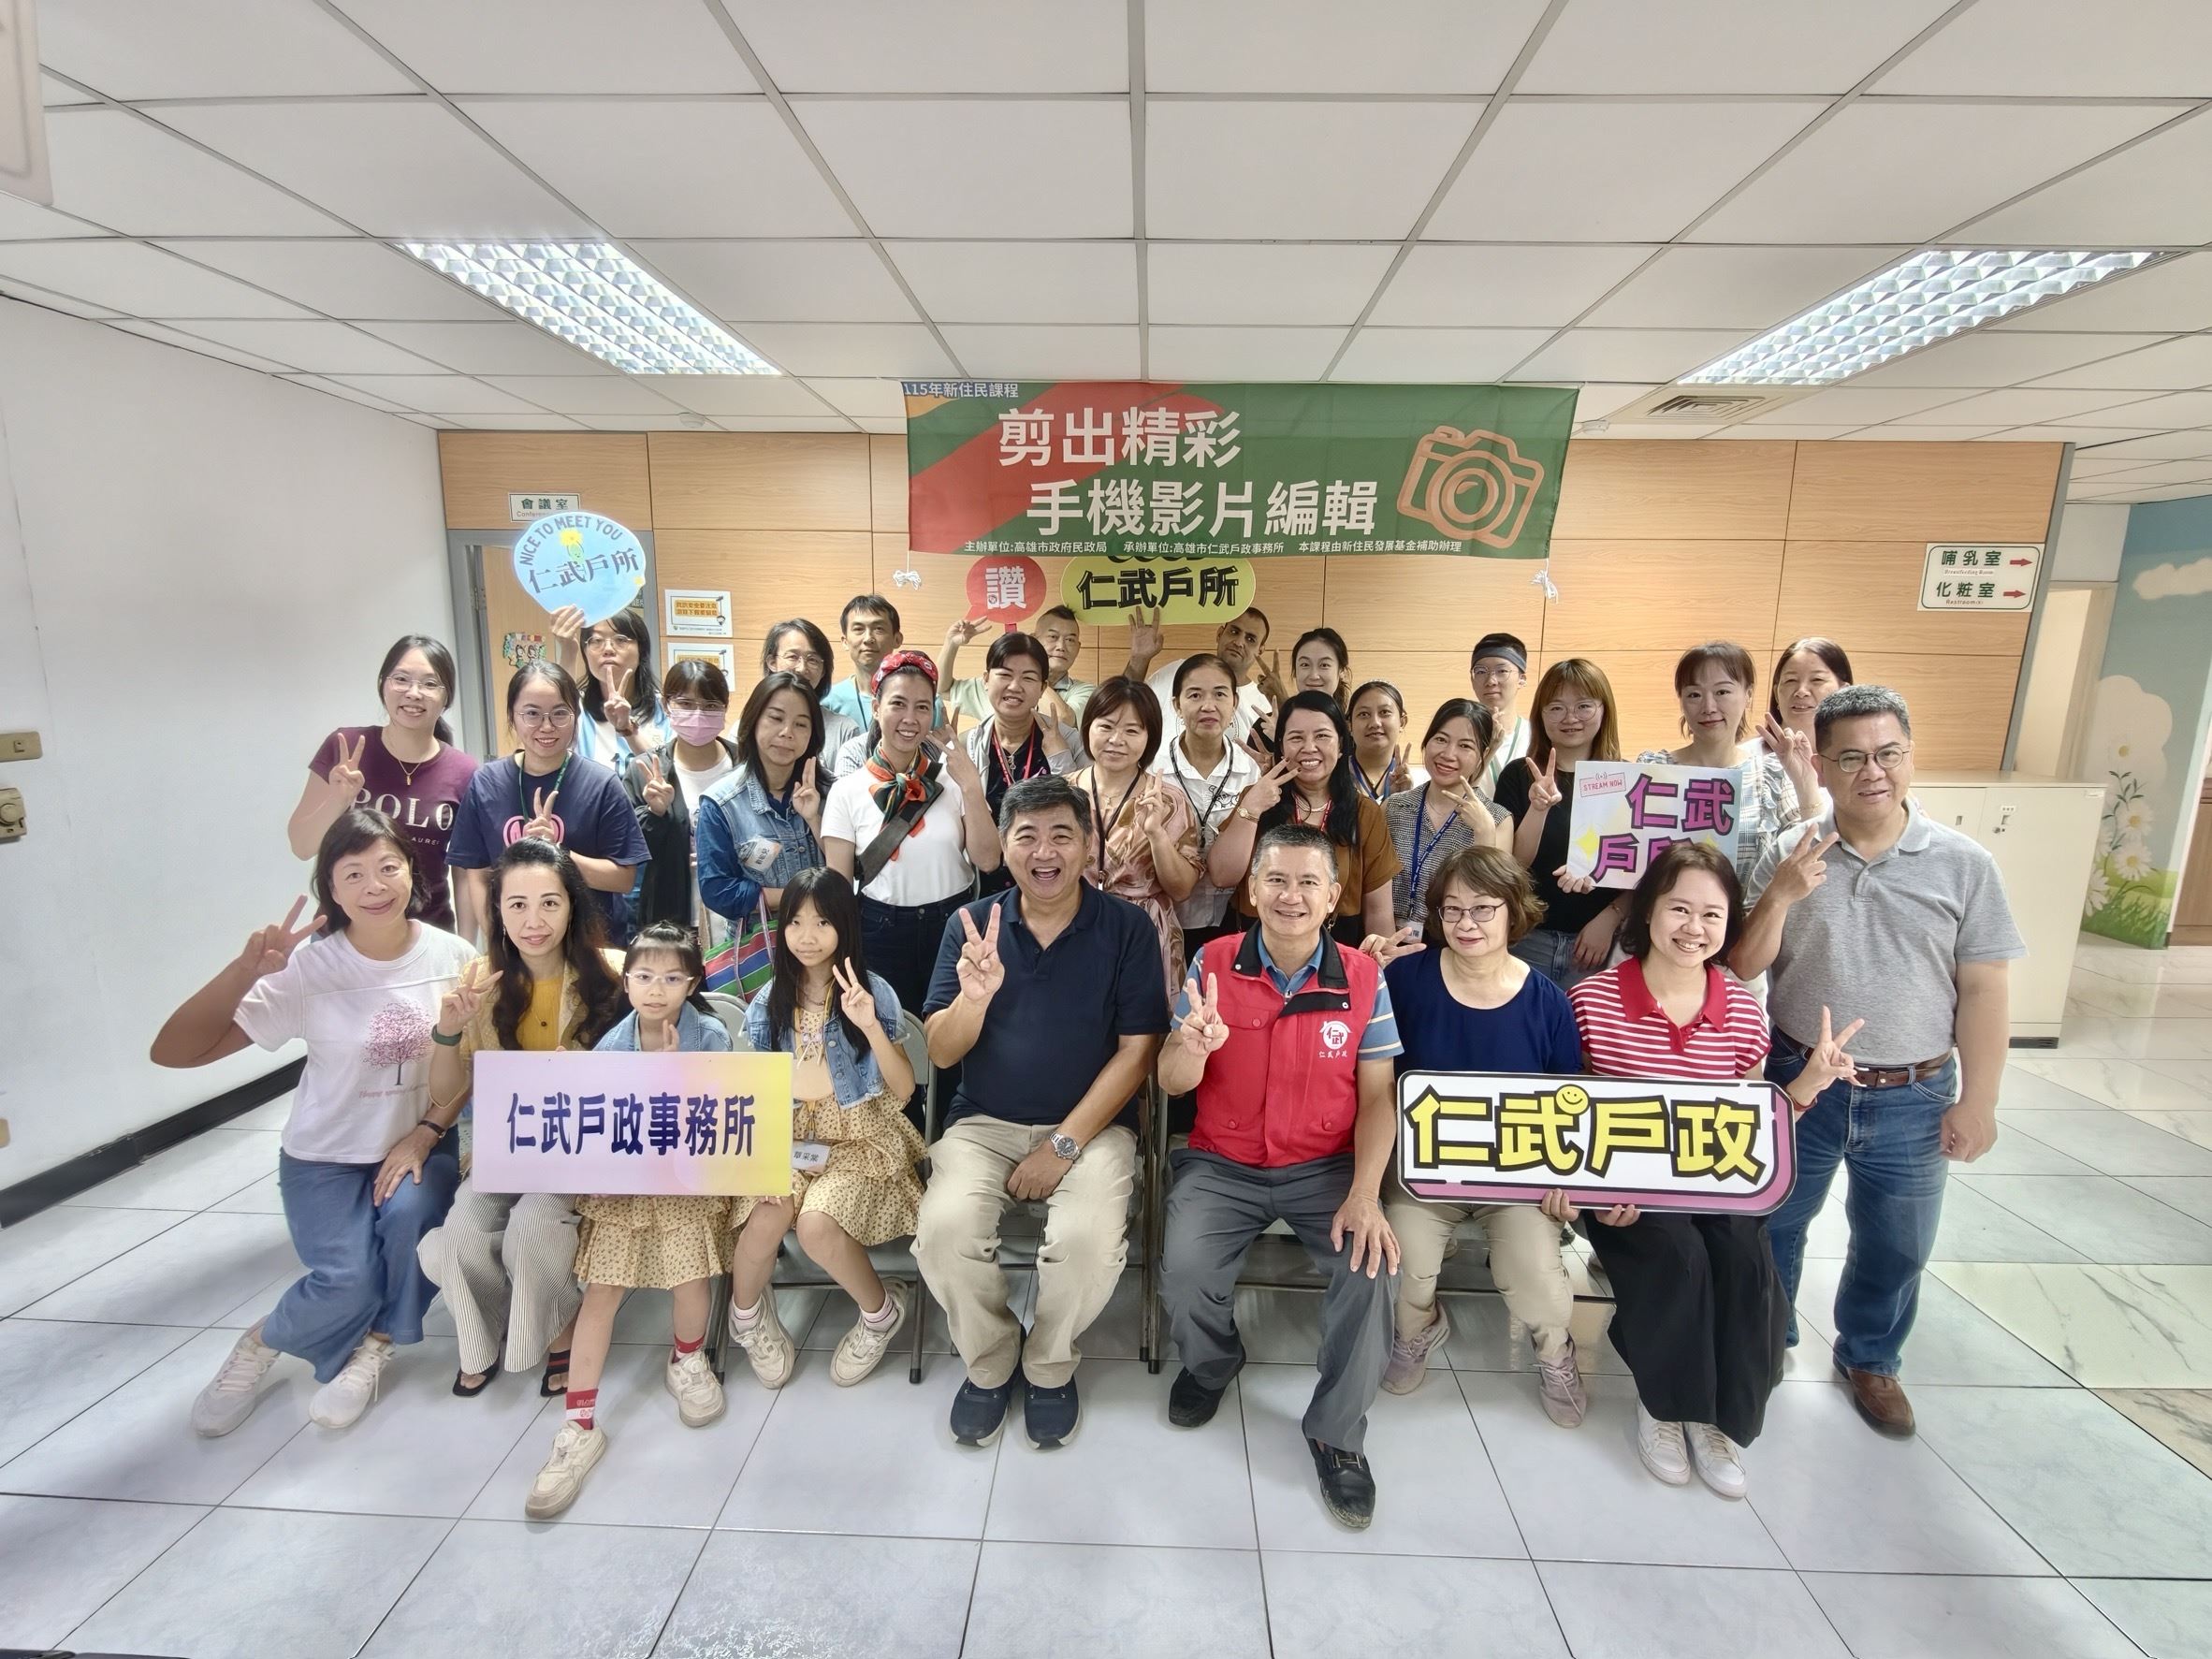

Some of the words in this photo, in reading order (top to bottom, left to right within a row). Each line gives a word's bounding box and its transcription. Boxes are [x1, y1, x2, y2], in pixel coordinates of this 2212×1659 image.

[904, 383, 1018, 398] 115年新住民課程
[998, 407, 1242, 468] 剪出精彩
[521, 498, 568, 510] 會議室
[1026, 479, 1377, 538] 手機影片編輯
[519, 535, 541, 566] NICE
[534, 522, 554, 539] TO
[554, 516, 591, 531] MEET
[596, 518, 623, 541] YOU
[965, 541, 1107, 553] 主辦單位:高雄市政府民政局
[1124, 541, 1284, 554] 承辦單位:高雄市仁武戶政事務所
[1299, 540, 1462, 553] 本課程由新住民發展基金補助辦理
[1942, 550, 2001, 566] 哺乳室
[529, 547, 639, 594] 仁武戶所
[985, 566, 1026, 609] 讚
[1076, 566, 1239, 610] 仁武戶所
[1936, 581, 1995, 598] 化粧室
[1583, 782, 1608, 792] STREAM
[1625, 773, 1736, 836] 仁武
[351, 788, 454, 831] POLO
[507, 1092, 756, 1157] 仁武戶政事務所
[1404, 1084, 1766, 1186] 仁武戶政
